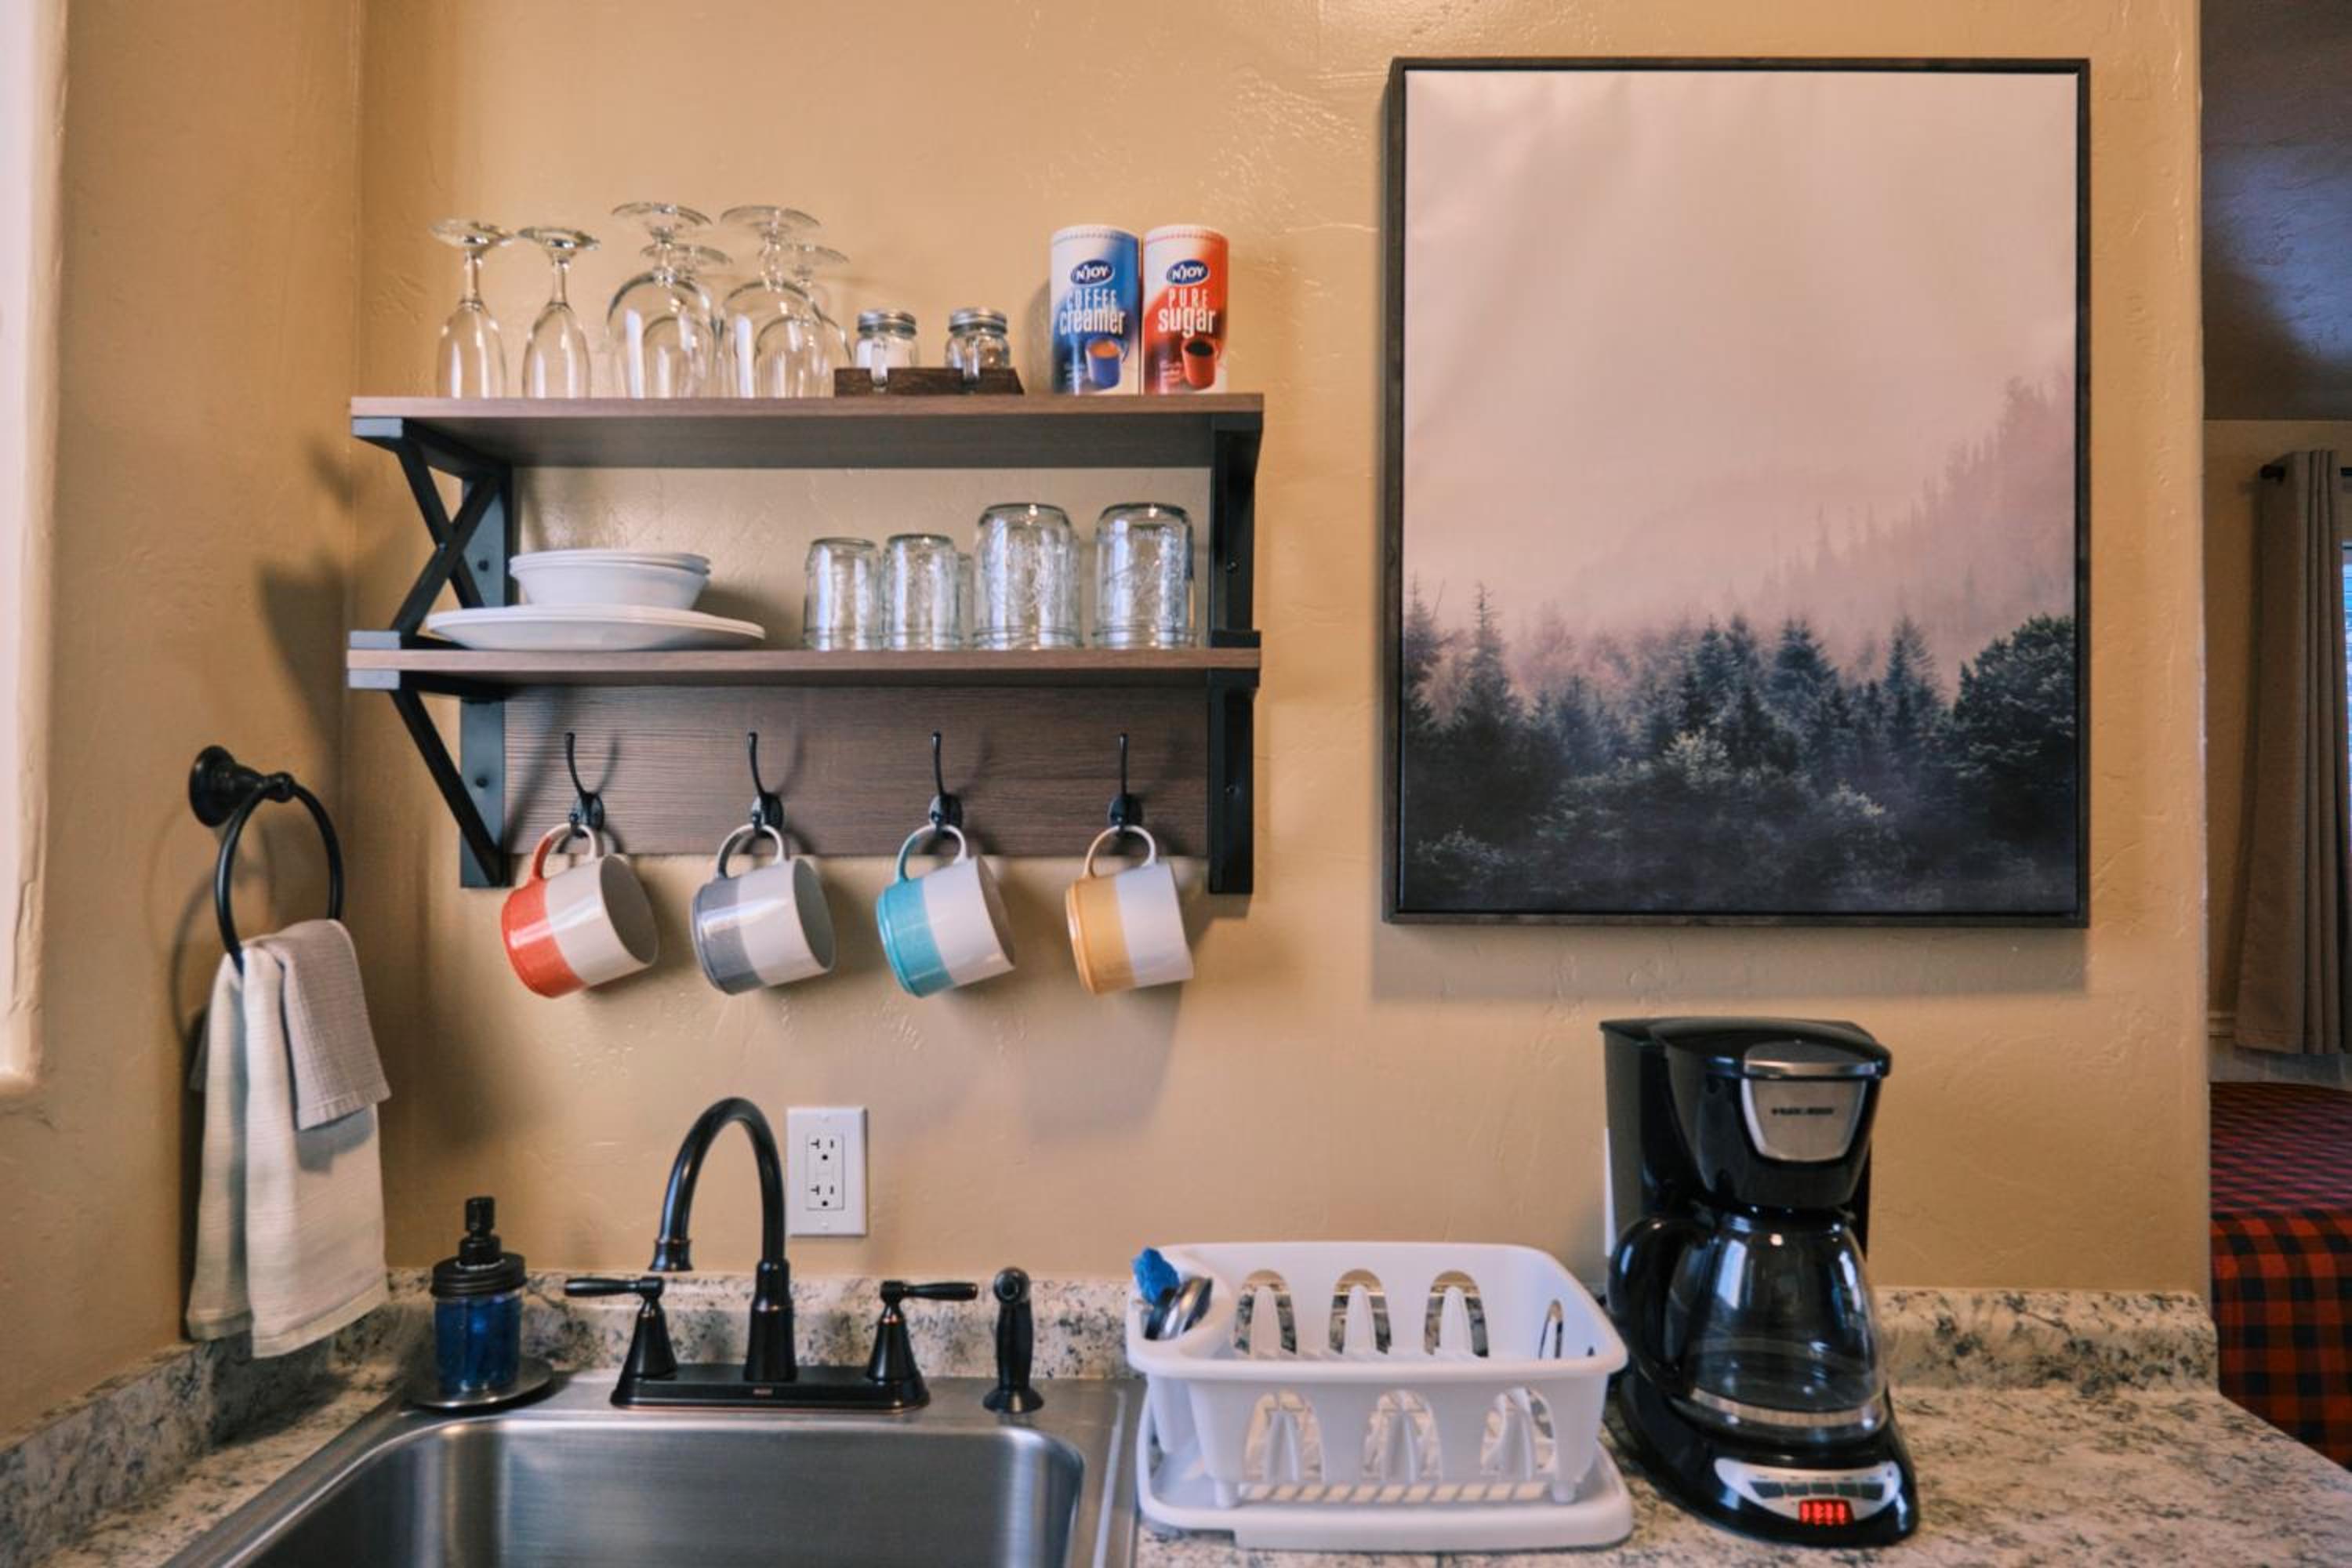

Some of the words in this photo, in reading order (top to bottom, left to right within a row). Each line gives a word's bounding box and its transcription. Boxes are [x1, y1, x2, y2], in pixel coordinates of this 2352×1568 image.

[1066, 288, 1117, 308] COFFEE
[1168, 288, 1208, 308] PURE
[1059, 307, 1126, 336] creamer
[1158, 307, 1217, 338] sugar
